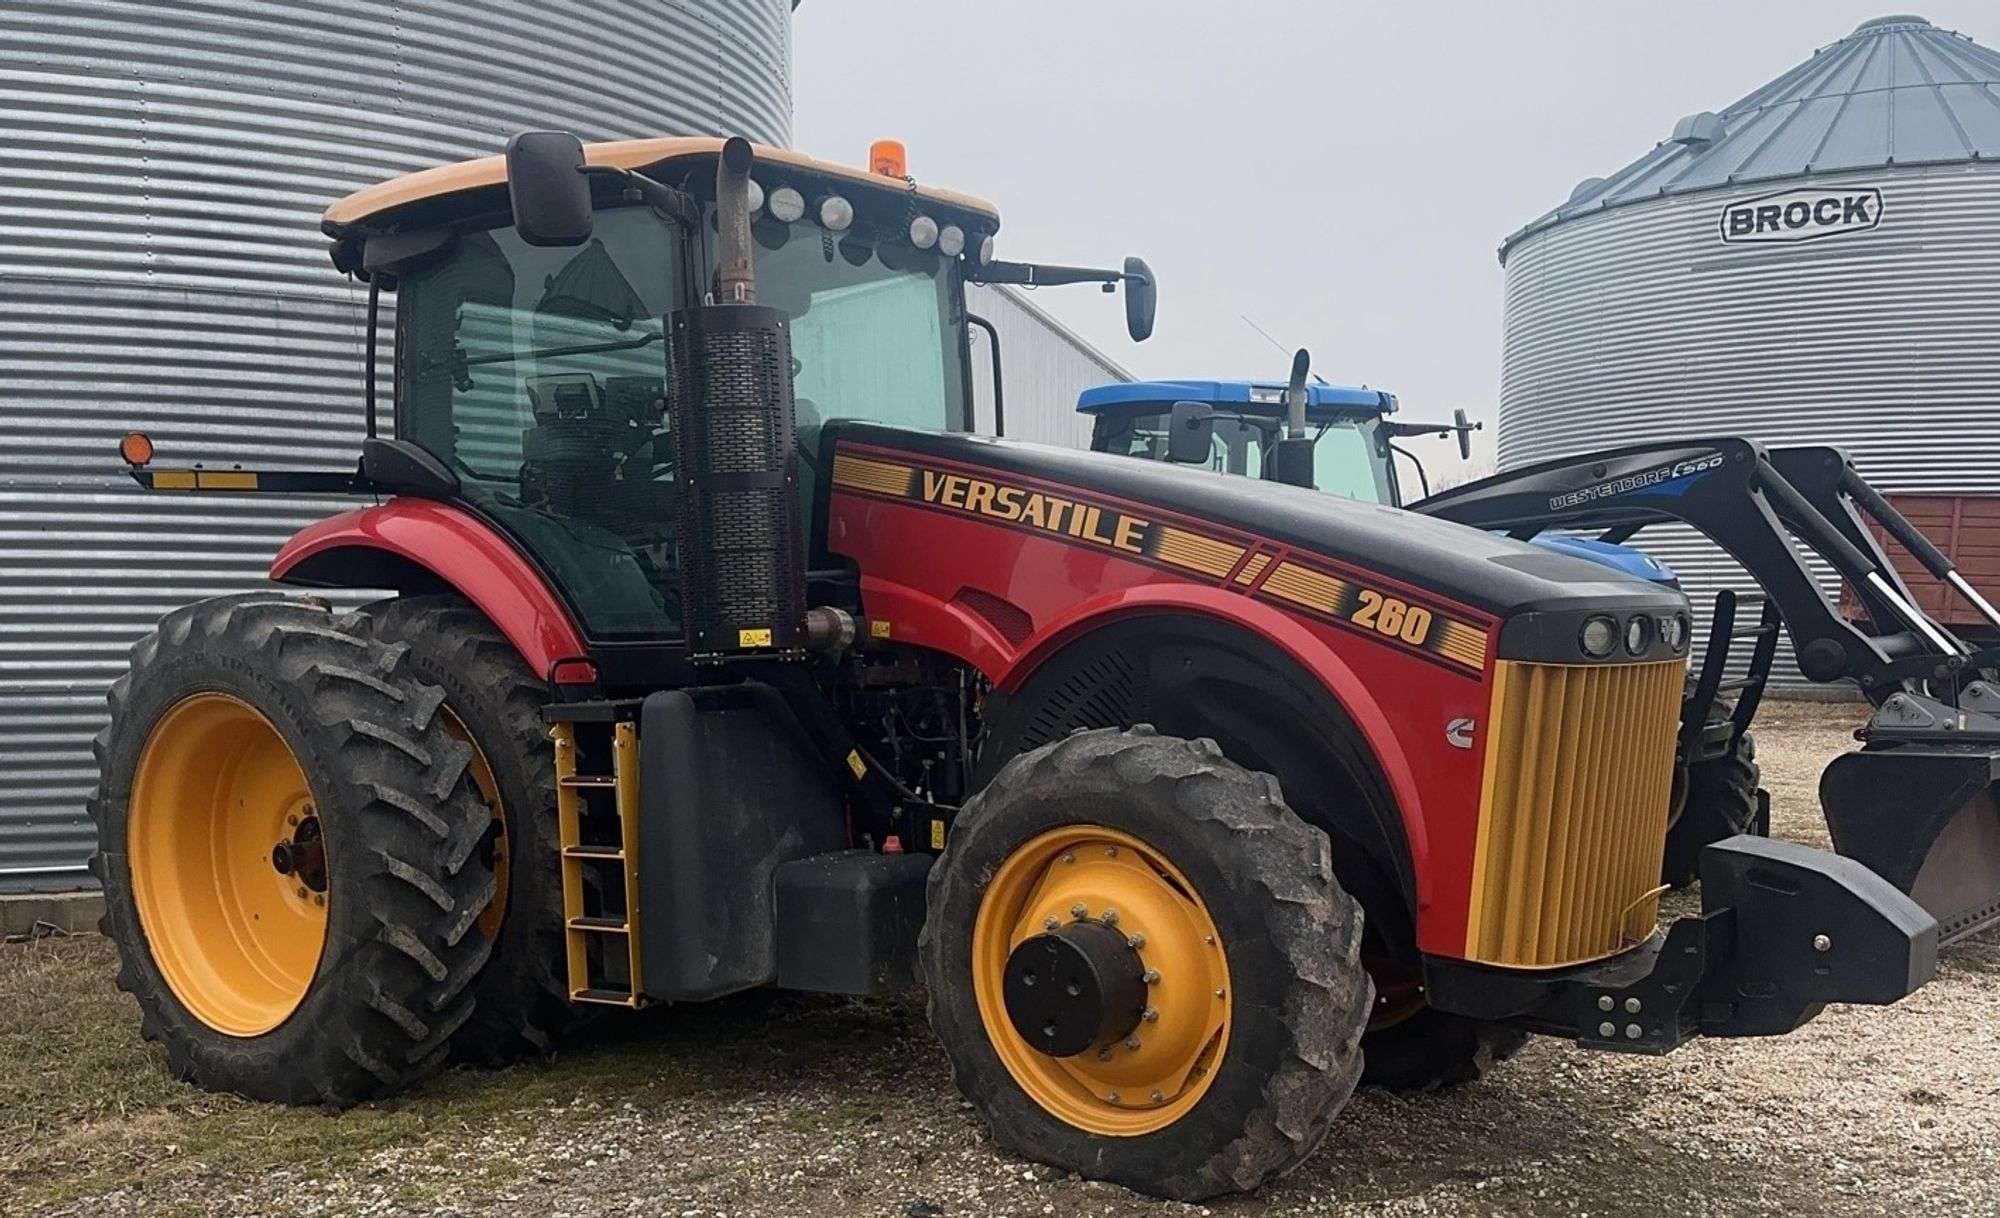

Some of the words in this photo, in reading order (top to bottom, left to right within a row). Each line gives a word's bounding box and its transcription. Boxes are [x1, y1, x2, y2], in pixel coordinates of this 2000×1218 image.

[1729, 195, 1872, 236] BROCK
[922, 469, 1149, 553] VERSATILE
[1549, 467, 1670, 511] WESTENDORF
[1350, 589, 1432, 645] 260
